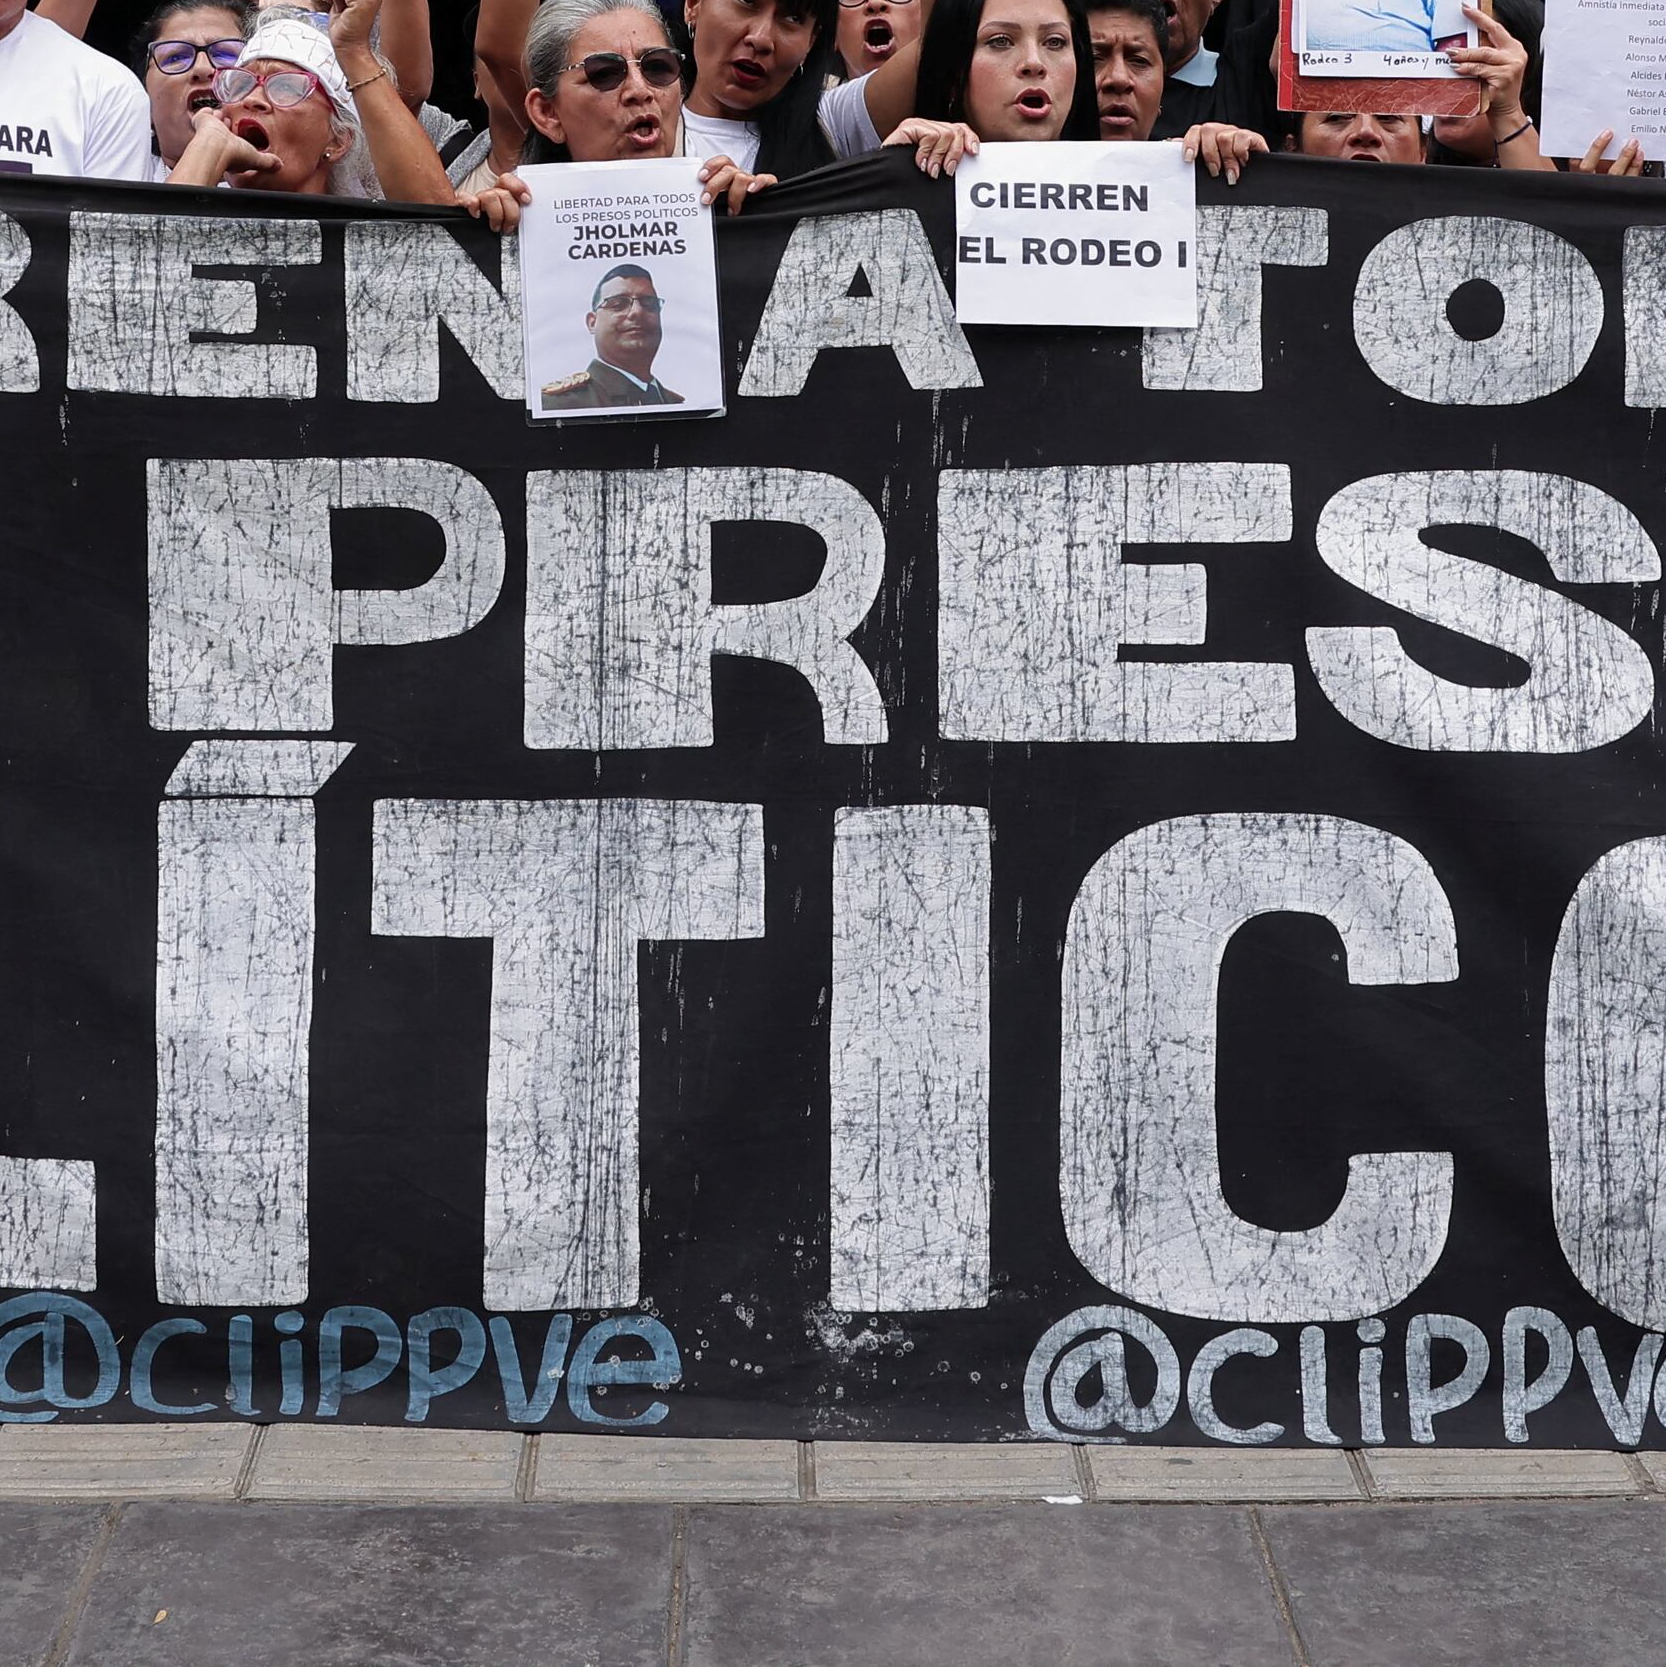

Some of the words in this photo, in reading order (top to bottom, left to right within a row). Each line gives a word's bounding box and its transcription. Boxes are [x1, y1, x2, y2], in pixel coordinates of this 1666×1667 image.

[1578, 0, 1617, 10] Amnistía
[1619, 0, 1665, 12] inmediata
[1625, 52, 1656, 63] Alonso
[1630, 71, 1662, 81] Alcides
[1627, 88, 1656, 98] Néstor
[1629, 107, 1661, 117] Gabriel
[1631, 124, 1658, 134] Emilio
[554, 197, 613, 209] LIBERTAD
[616, 195, 650, 207] PARA
[653, 193, 696, 205] TODOS
[969, 182, 1149, 212] CIERREN
[555, 213, 579, 223] LOS
[582, 211, 631, 222] PRESOS
[634, 207, 699, 220] POLITICOS
[573, 221, 678, 241] JHOLMAR
[568, 239, 687, 260] CARDENAS
[959, 236, 1007, 264] EL
[1021, 237, 1162, 268] RODEO
[738, 209, 984, 398] A
